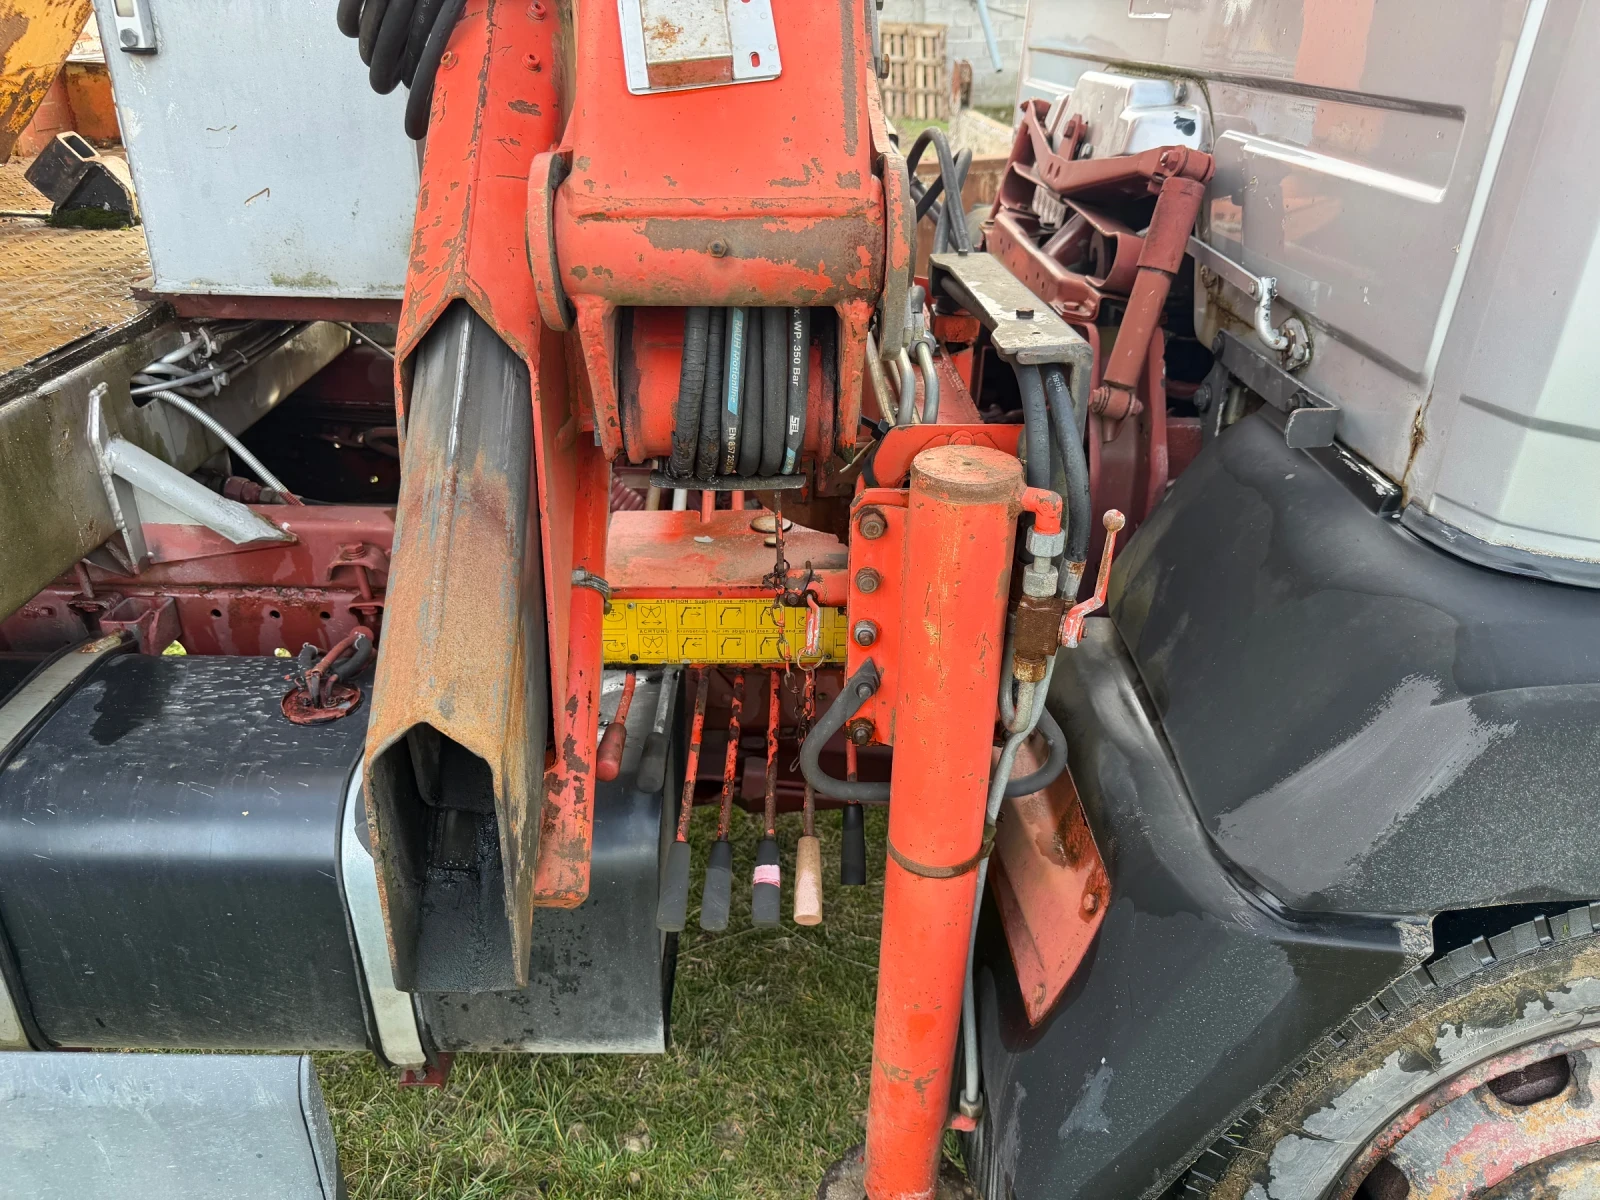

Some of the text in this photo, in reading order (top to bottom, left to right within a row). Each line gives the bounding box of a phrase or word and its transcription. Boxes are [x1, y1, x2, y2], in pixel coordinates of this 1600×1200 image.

[733, 319, 743, 348] RAUH
[793, 320, 802, 342] WP.
[793, 345, 802, 364] 350
[730, 349, 742, 403] Motionline
[792, 367, 801, 387] Bar
[728, 427, 737, 440] EN
[727, 441, 736, 454] 857
